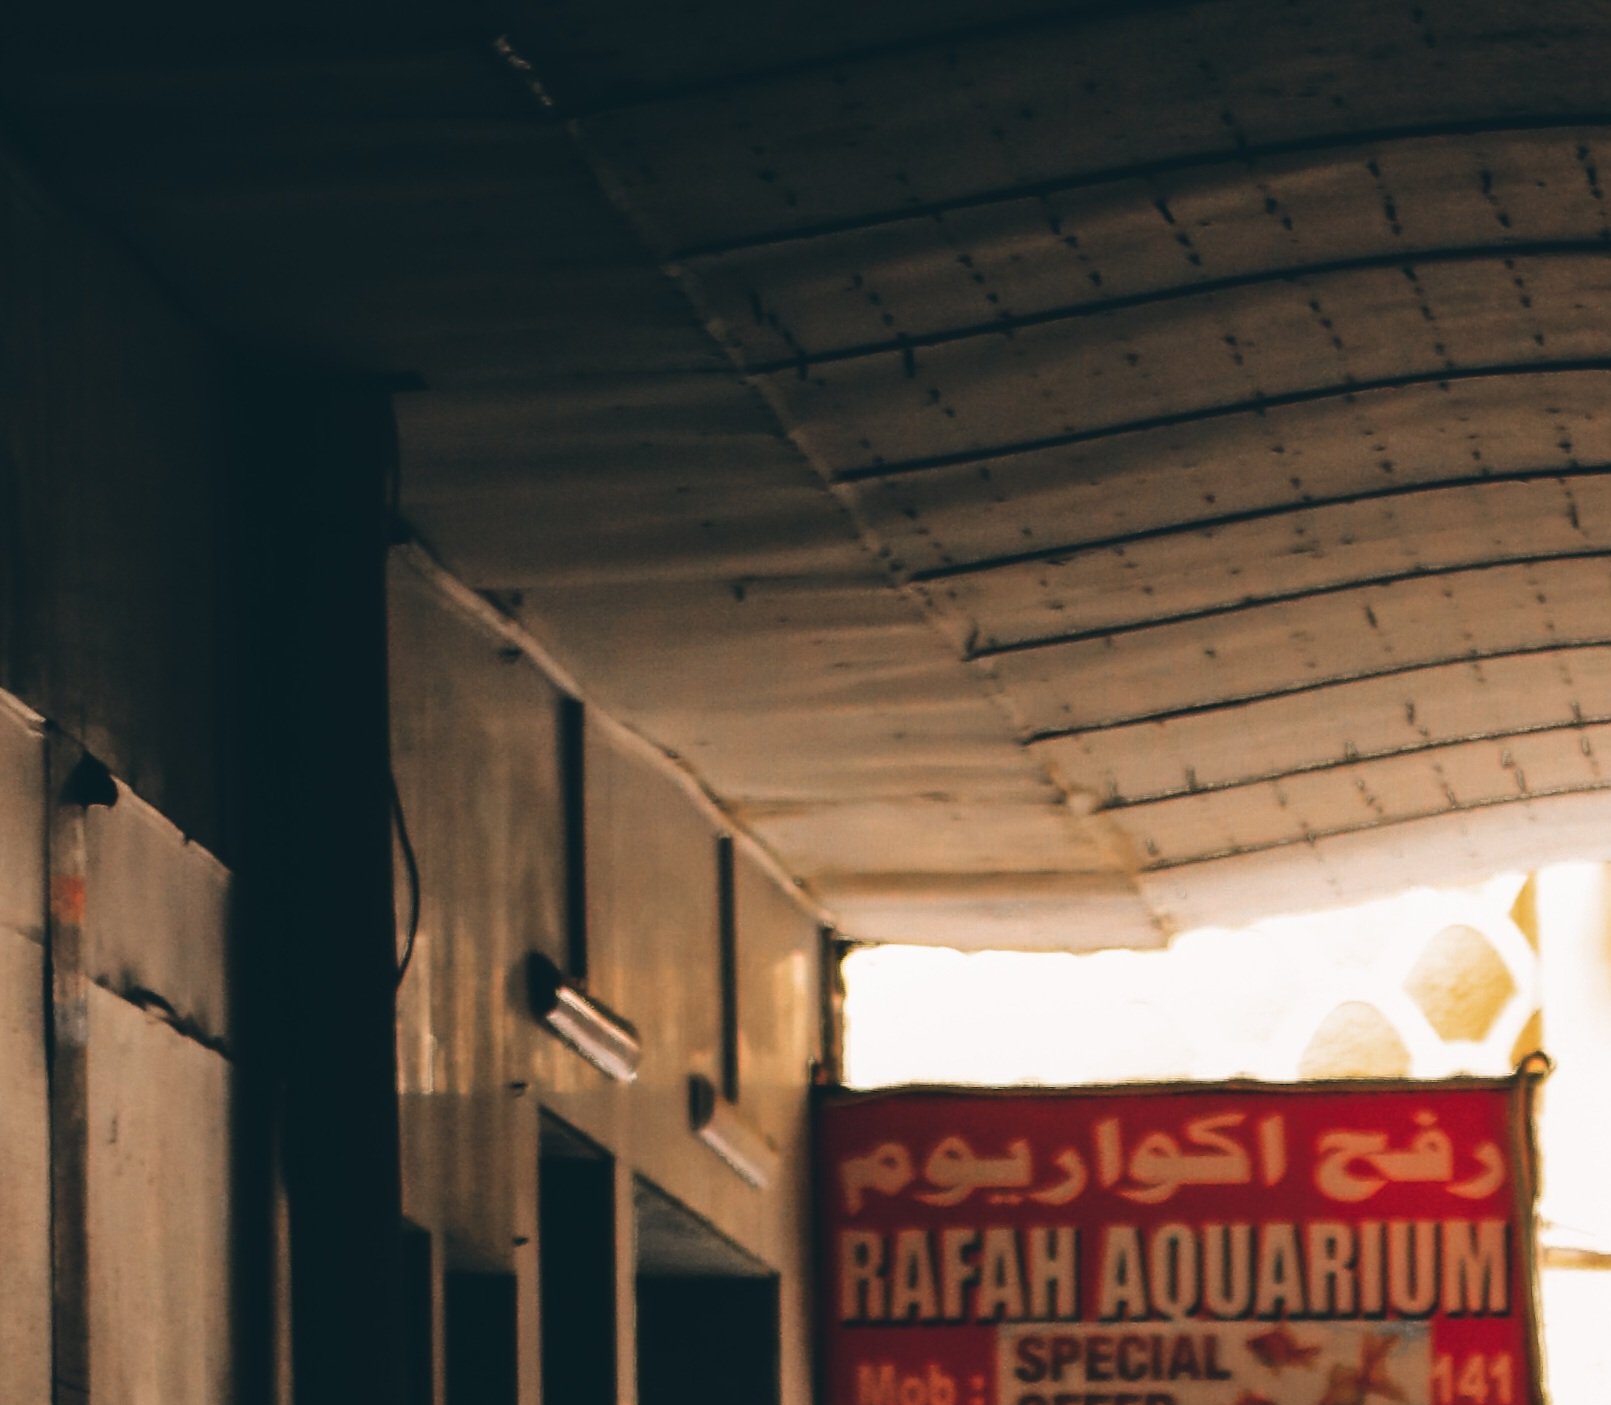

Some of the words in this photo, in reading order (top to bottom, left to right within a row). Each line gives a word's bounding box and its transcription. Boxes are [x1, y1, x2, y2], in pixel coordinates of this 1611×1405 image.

[1315, 1109, 1505, 1203] رفح
[841, 1226, 1083, 1322] RAFAH
[1099, 1219, 1510, 1322] AQUARIUM
[1013, 1331, 1233, 1383] SPECIAL
